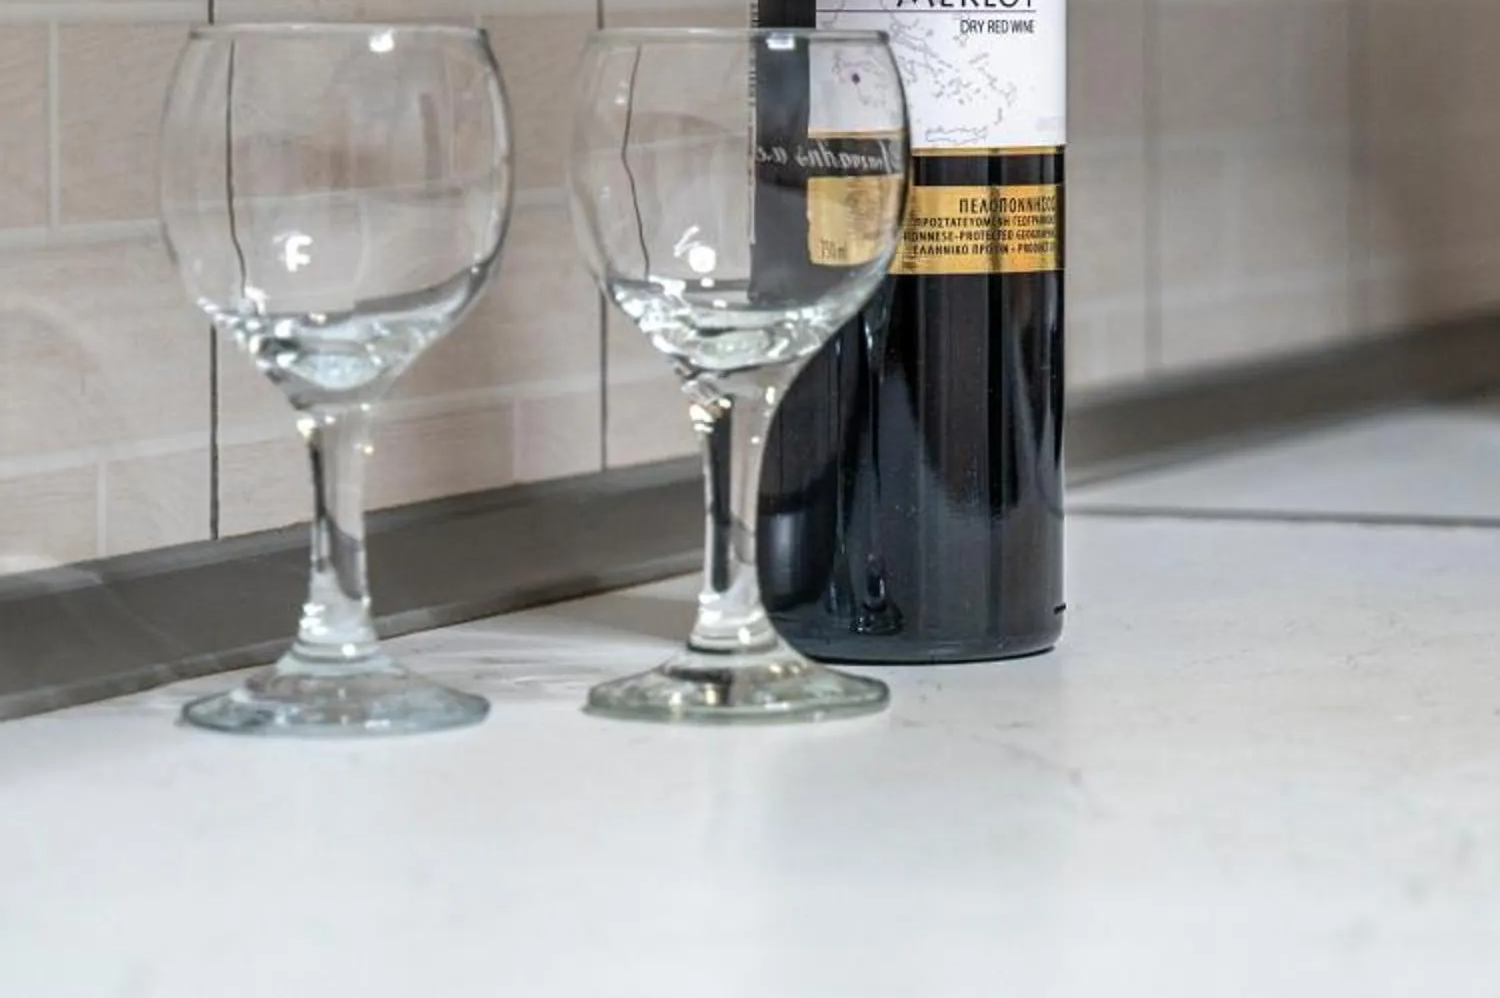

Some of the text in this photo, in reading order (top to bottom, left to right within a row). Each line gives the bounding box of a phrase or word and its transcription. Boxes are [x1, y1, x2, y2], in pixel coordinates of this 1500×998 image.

[960, 19, 1035, 34] DRY RED WINE
